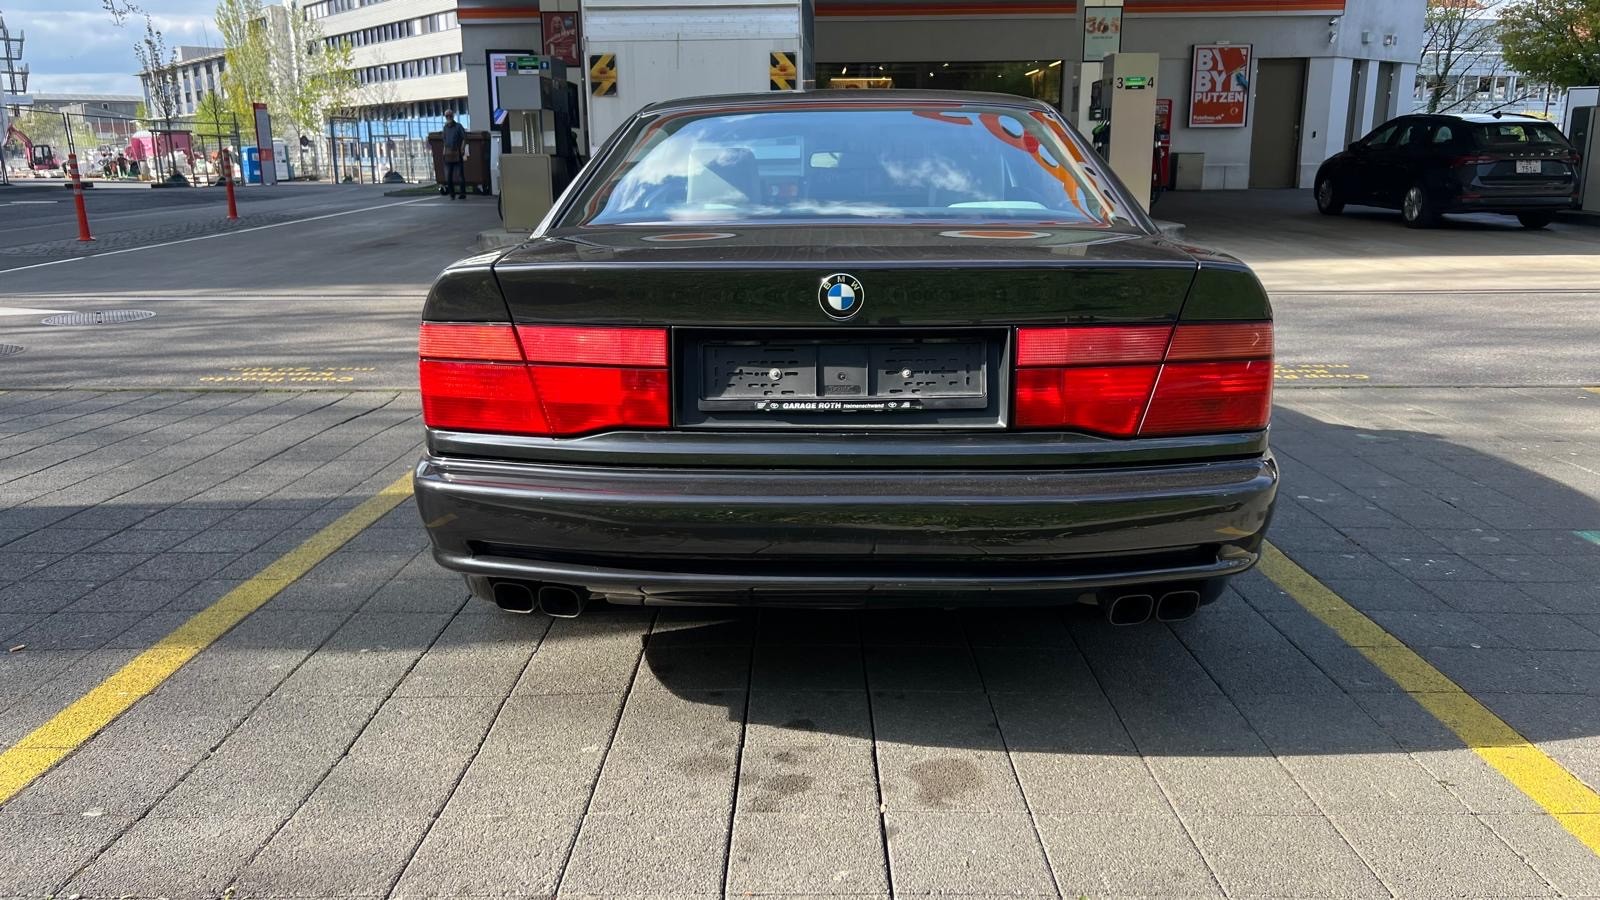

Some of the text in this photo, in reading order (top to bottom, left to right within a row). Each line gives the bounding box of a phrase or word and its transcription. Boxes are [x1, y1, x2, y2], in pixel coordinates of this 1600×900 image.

[1116, 77, 1124, 89] 3
[1147, 77, 1154, 88] 4
[1195, 92, 1243, 102] PUTZEN
[823, 275, 860, 290] BMW
